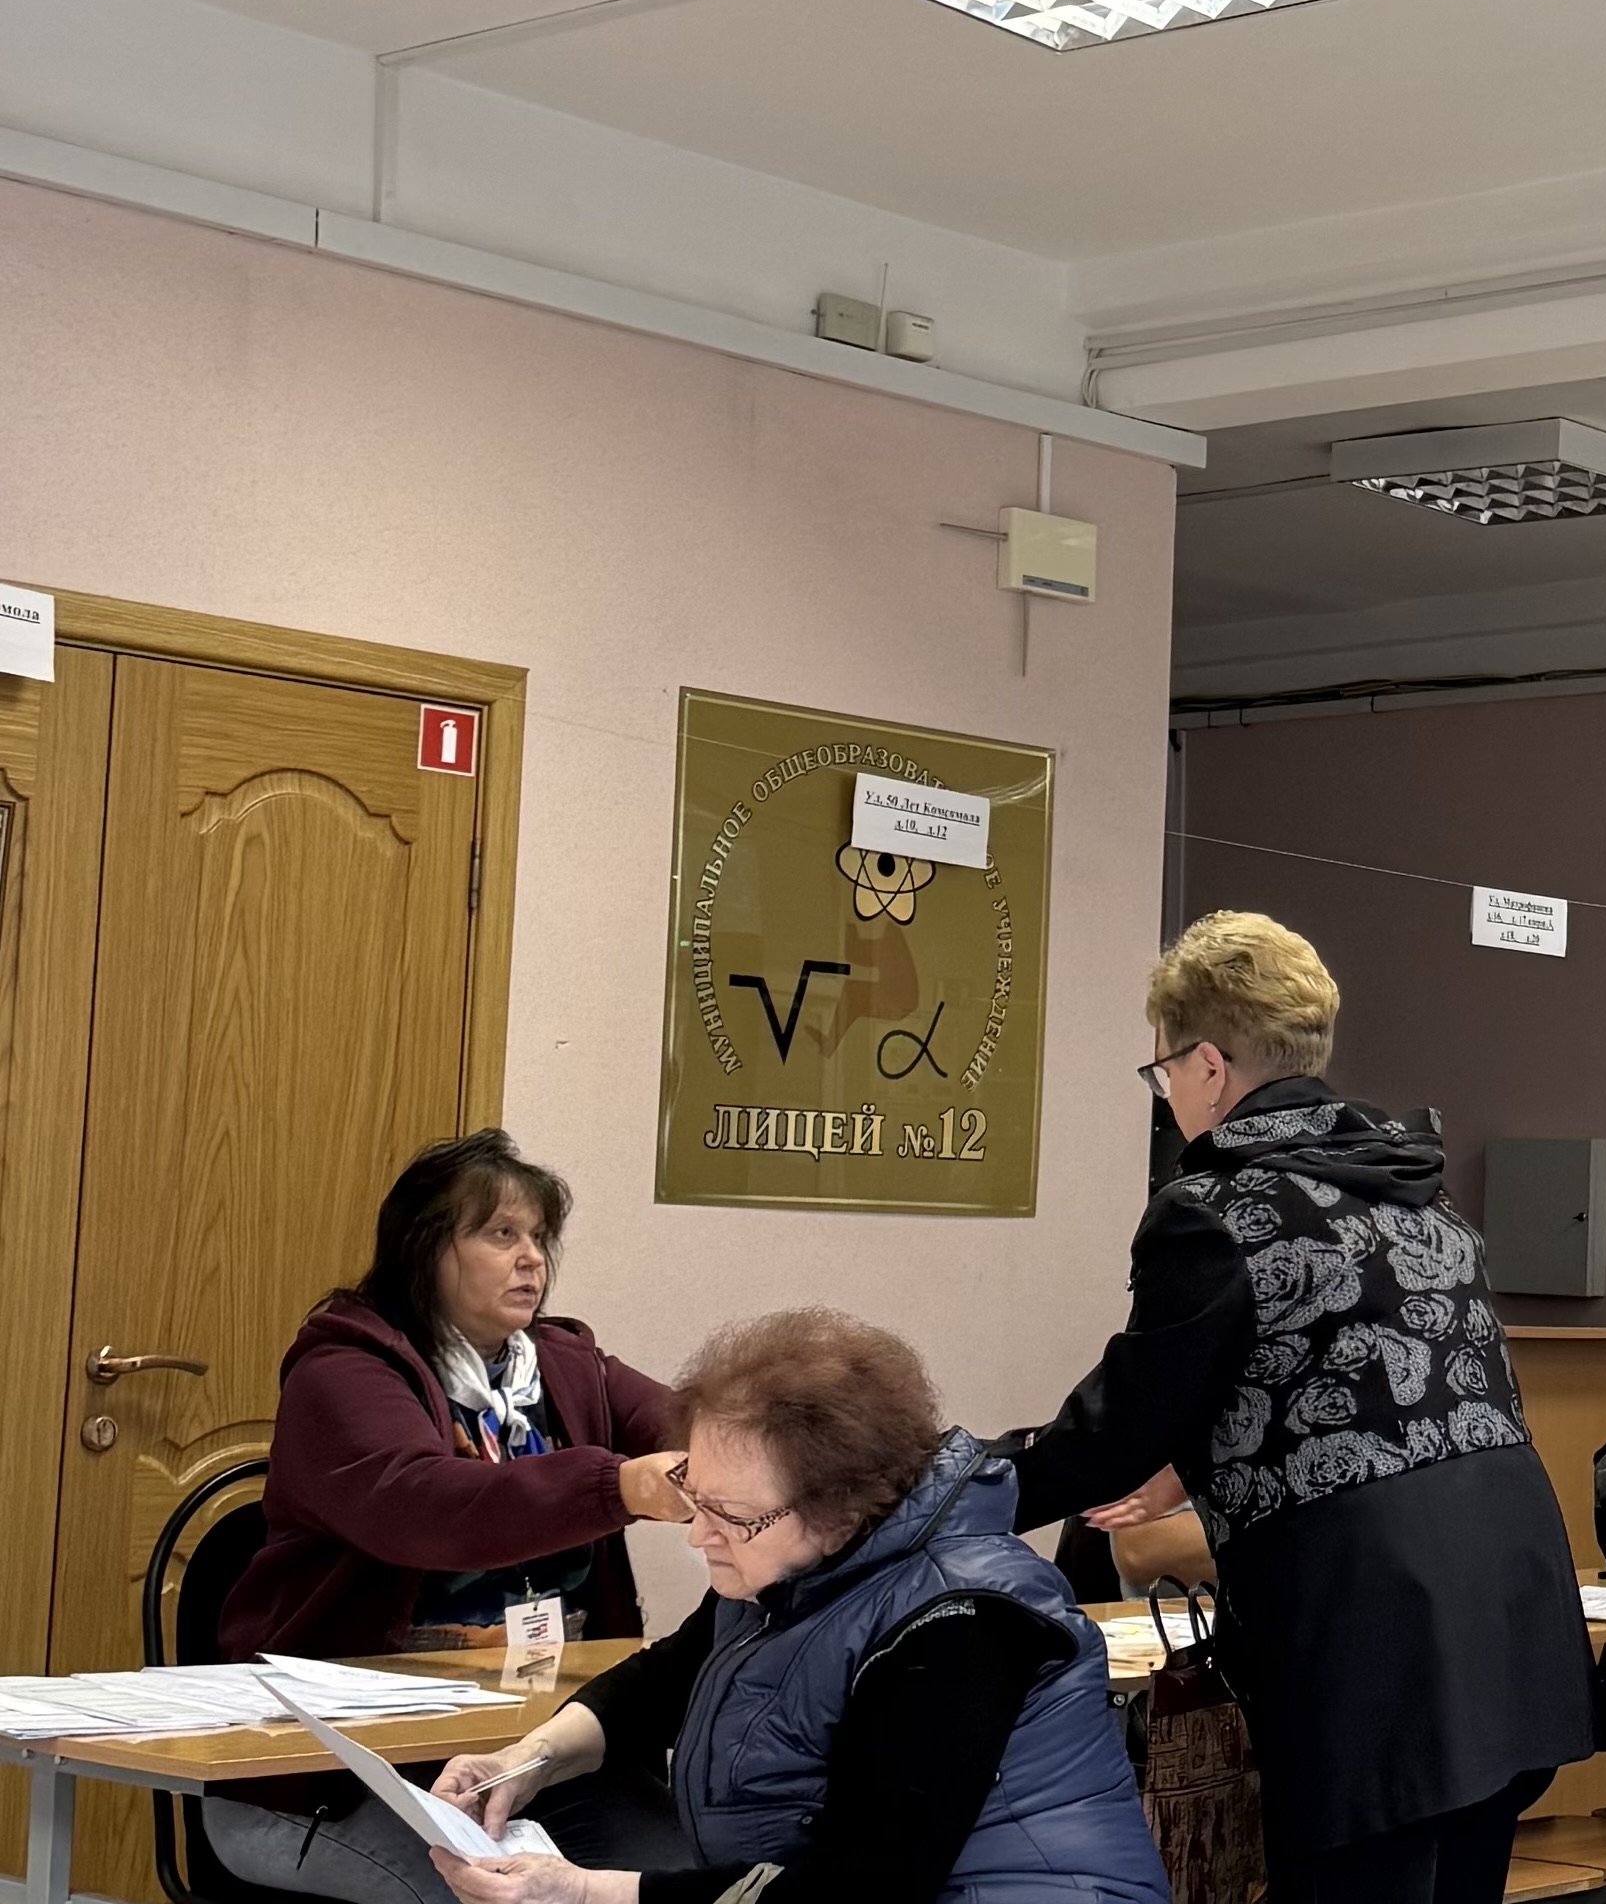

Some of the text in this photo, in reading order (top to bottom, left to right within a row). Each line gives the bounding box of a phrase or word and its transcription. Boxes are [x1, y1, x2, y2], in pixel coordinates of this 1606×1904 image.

[0, 603, 40, 621] мола
[886, 794, 899, 807] 50
[900, 797, 920, 812] Лет
[691, 800, 753, 1076] МУНИЦИПАЛЬНОЕ
[960, 895, 1013, 1094] УЧРЕЖДЕНИЕ
[704, 1103, 988, 1162] ЛИЦЕЙ №12
